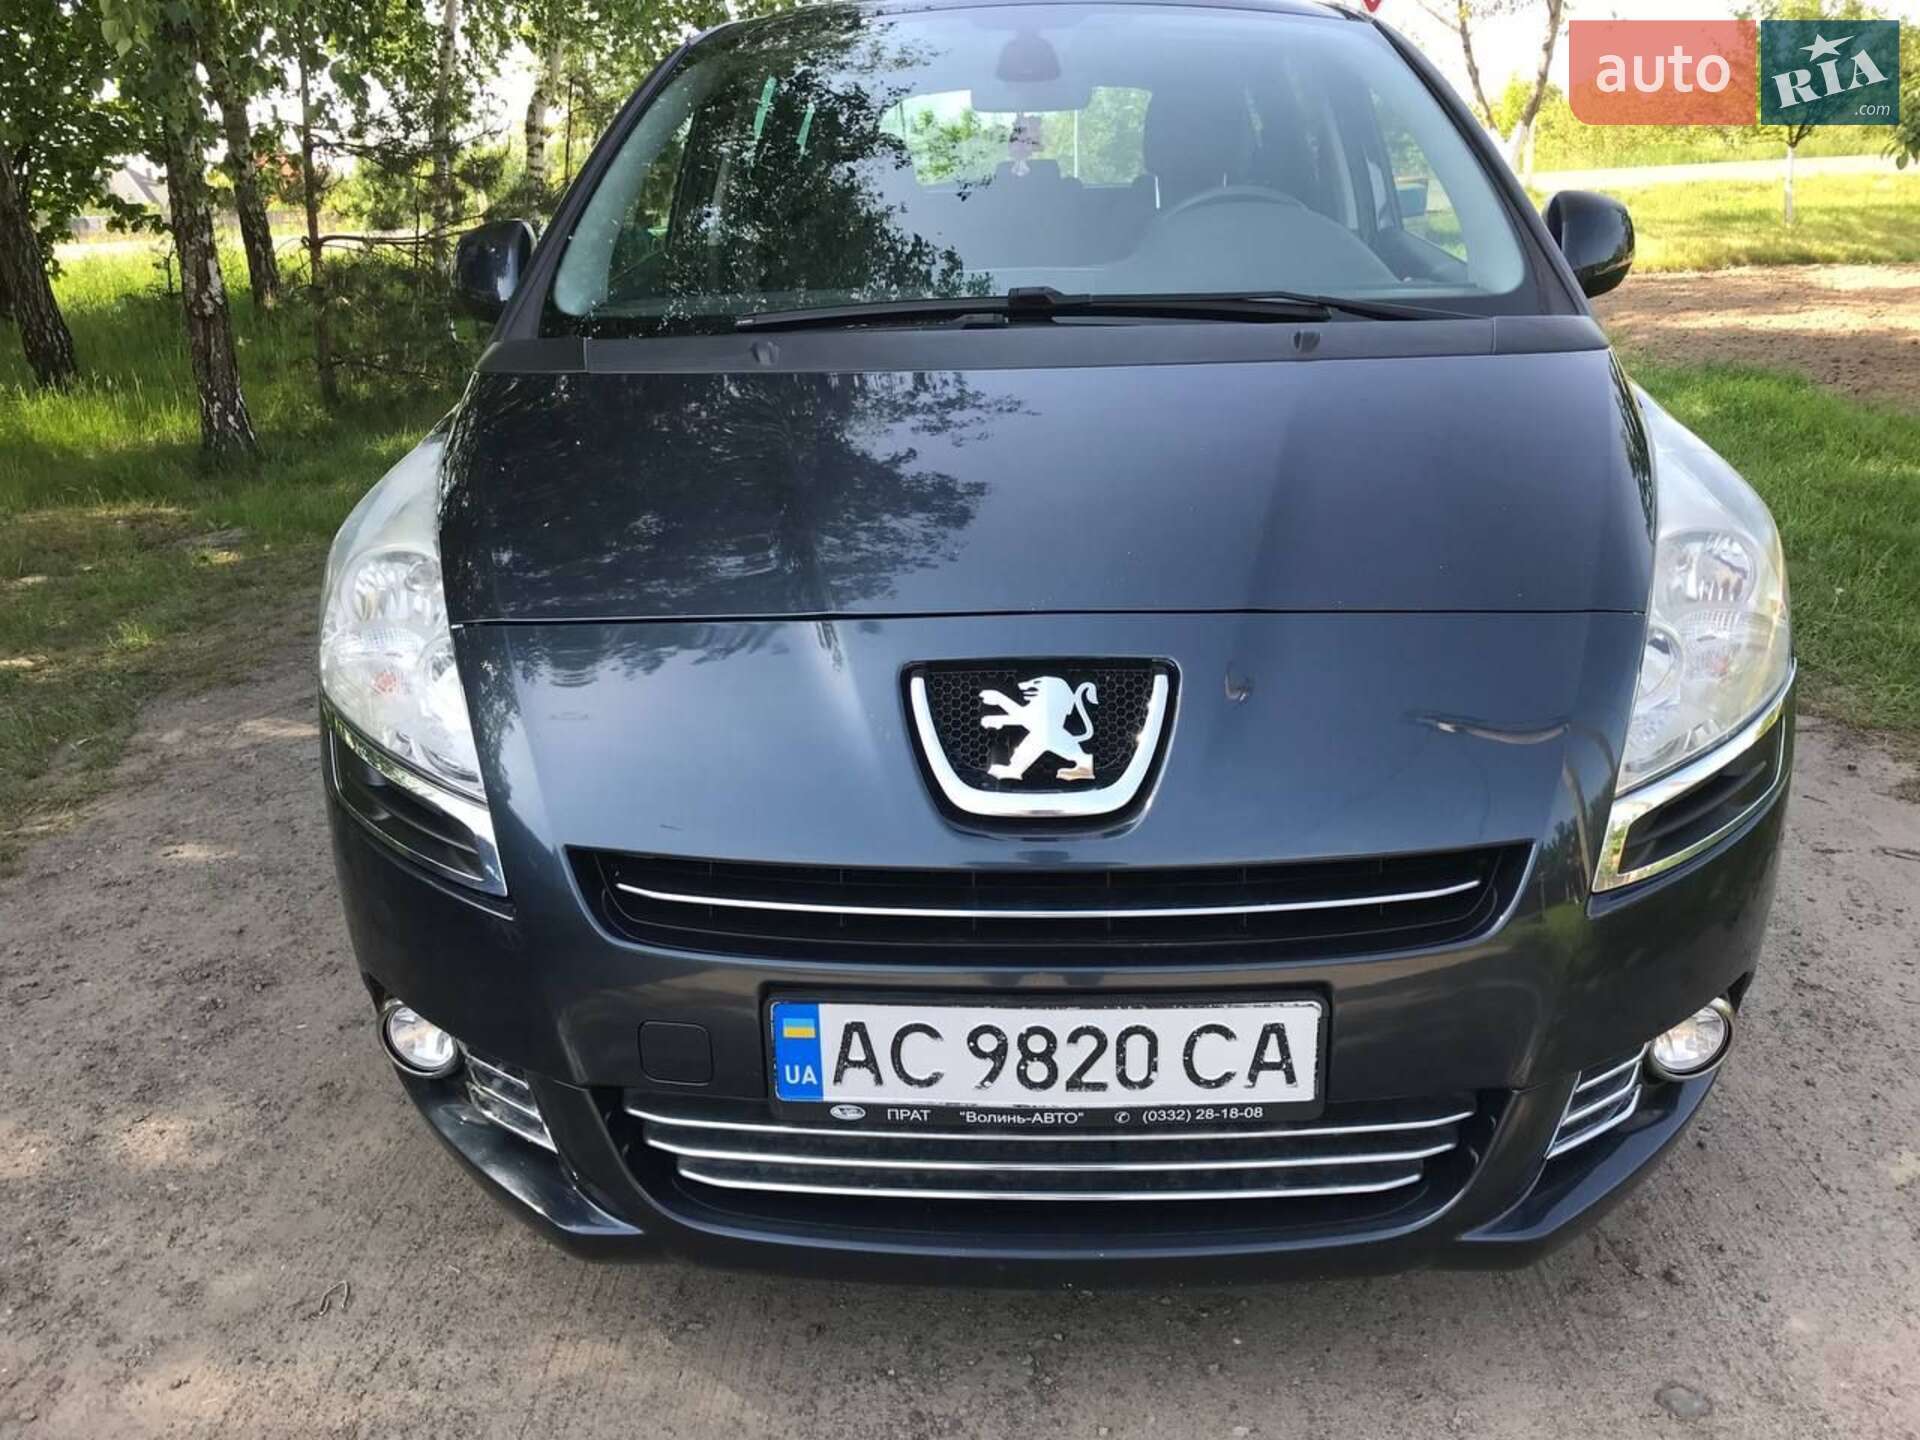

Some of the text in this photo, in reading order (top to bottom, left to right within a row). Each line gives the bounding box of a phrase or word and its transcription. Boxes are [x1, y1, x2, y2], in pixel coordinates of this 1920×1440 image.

[833, 1021, 1298, 1092] AC 9820 CA
[785, 1065, 818, 1085] UA
[887, 1107, 1263, 1124] ПРАТ "Волинь-АВТО" (0332) 28-18-08
